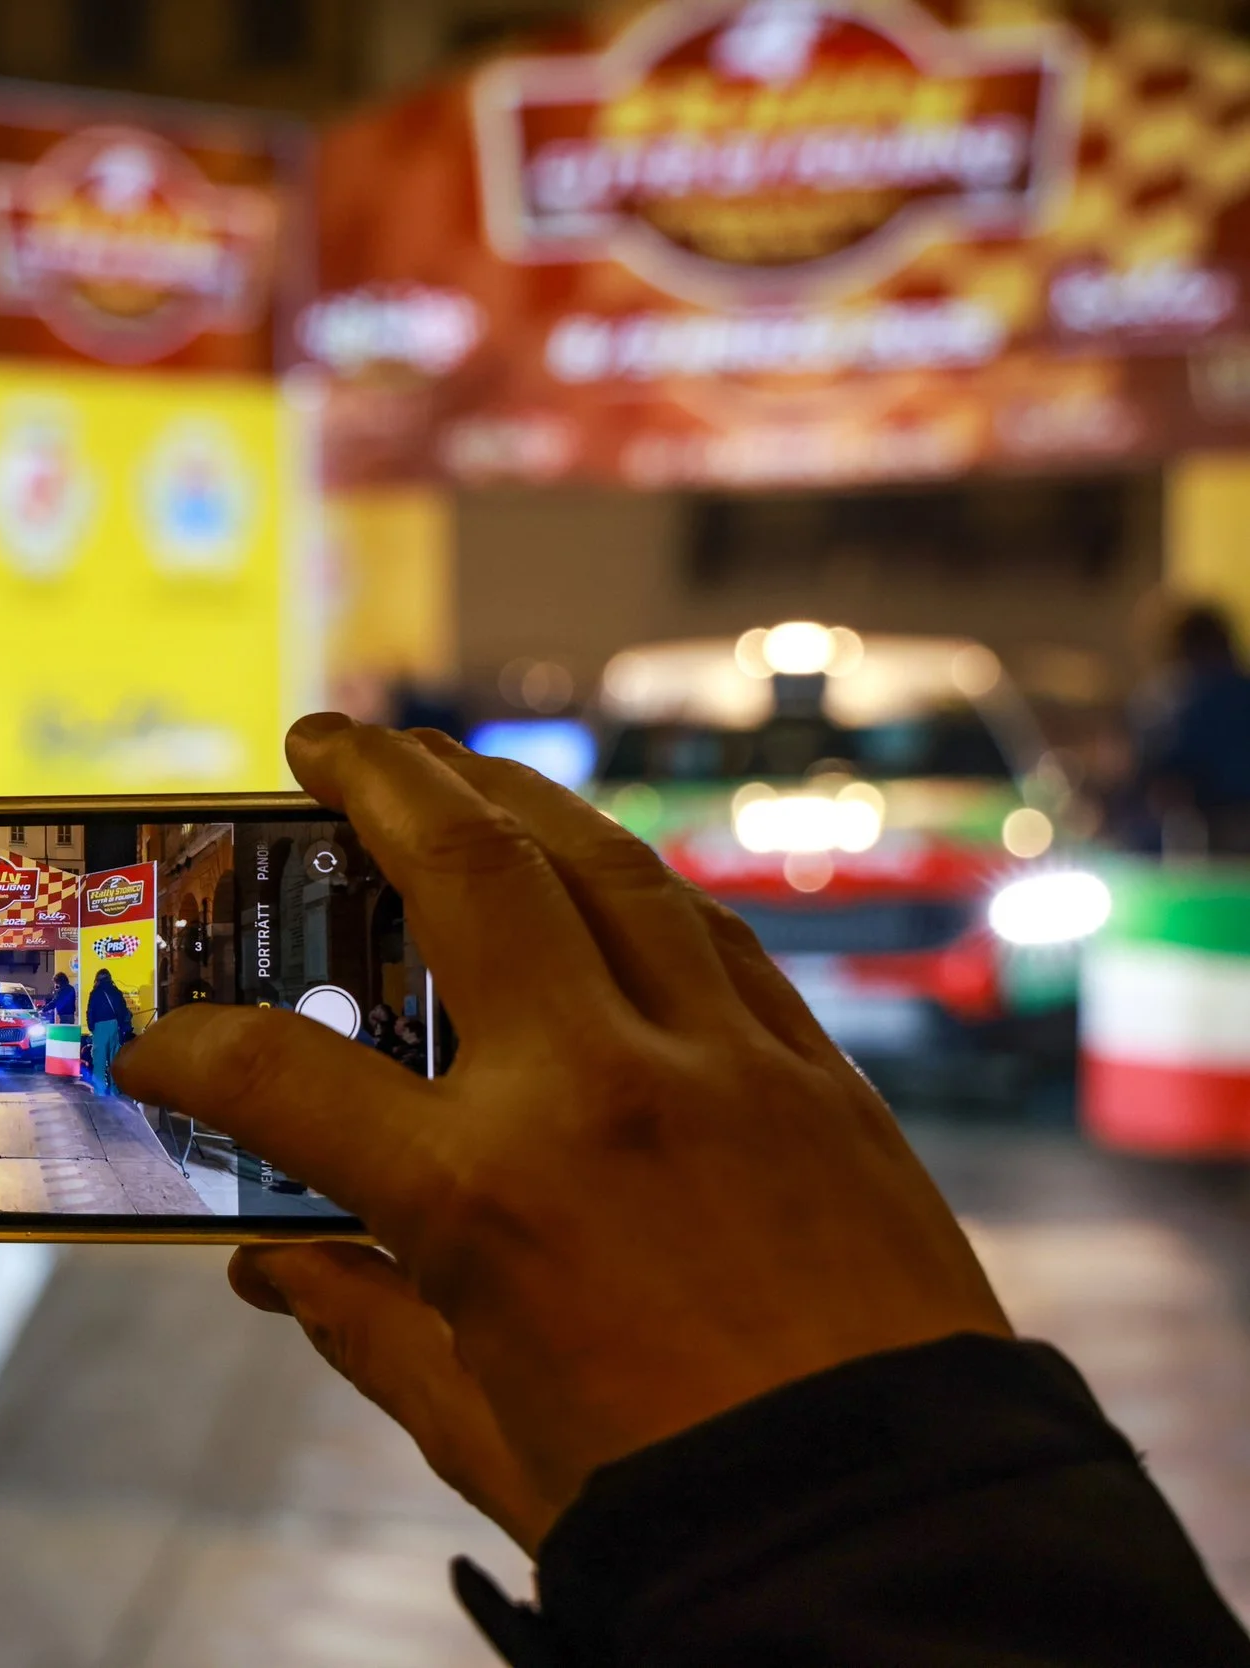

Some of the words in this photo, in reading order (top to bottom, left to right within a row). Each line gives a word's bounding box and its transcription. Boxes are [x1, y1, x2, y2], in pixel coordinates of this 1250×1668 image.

[38, 912, 66, 921] Rally
[3, 918, 27, 926] 2025
[254, 902, 271, 978] PORTRÄTT
[107, 942, 125, 952] PRS
[194, 941, 203, 952] 3
